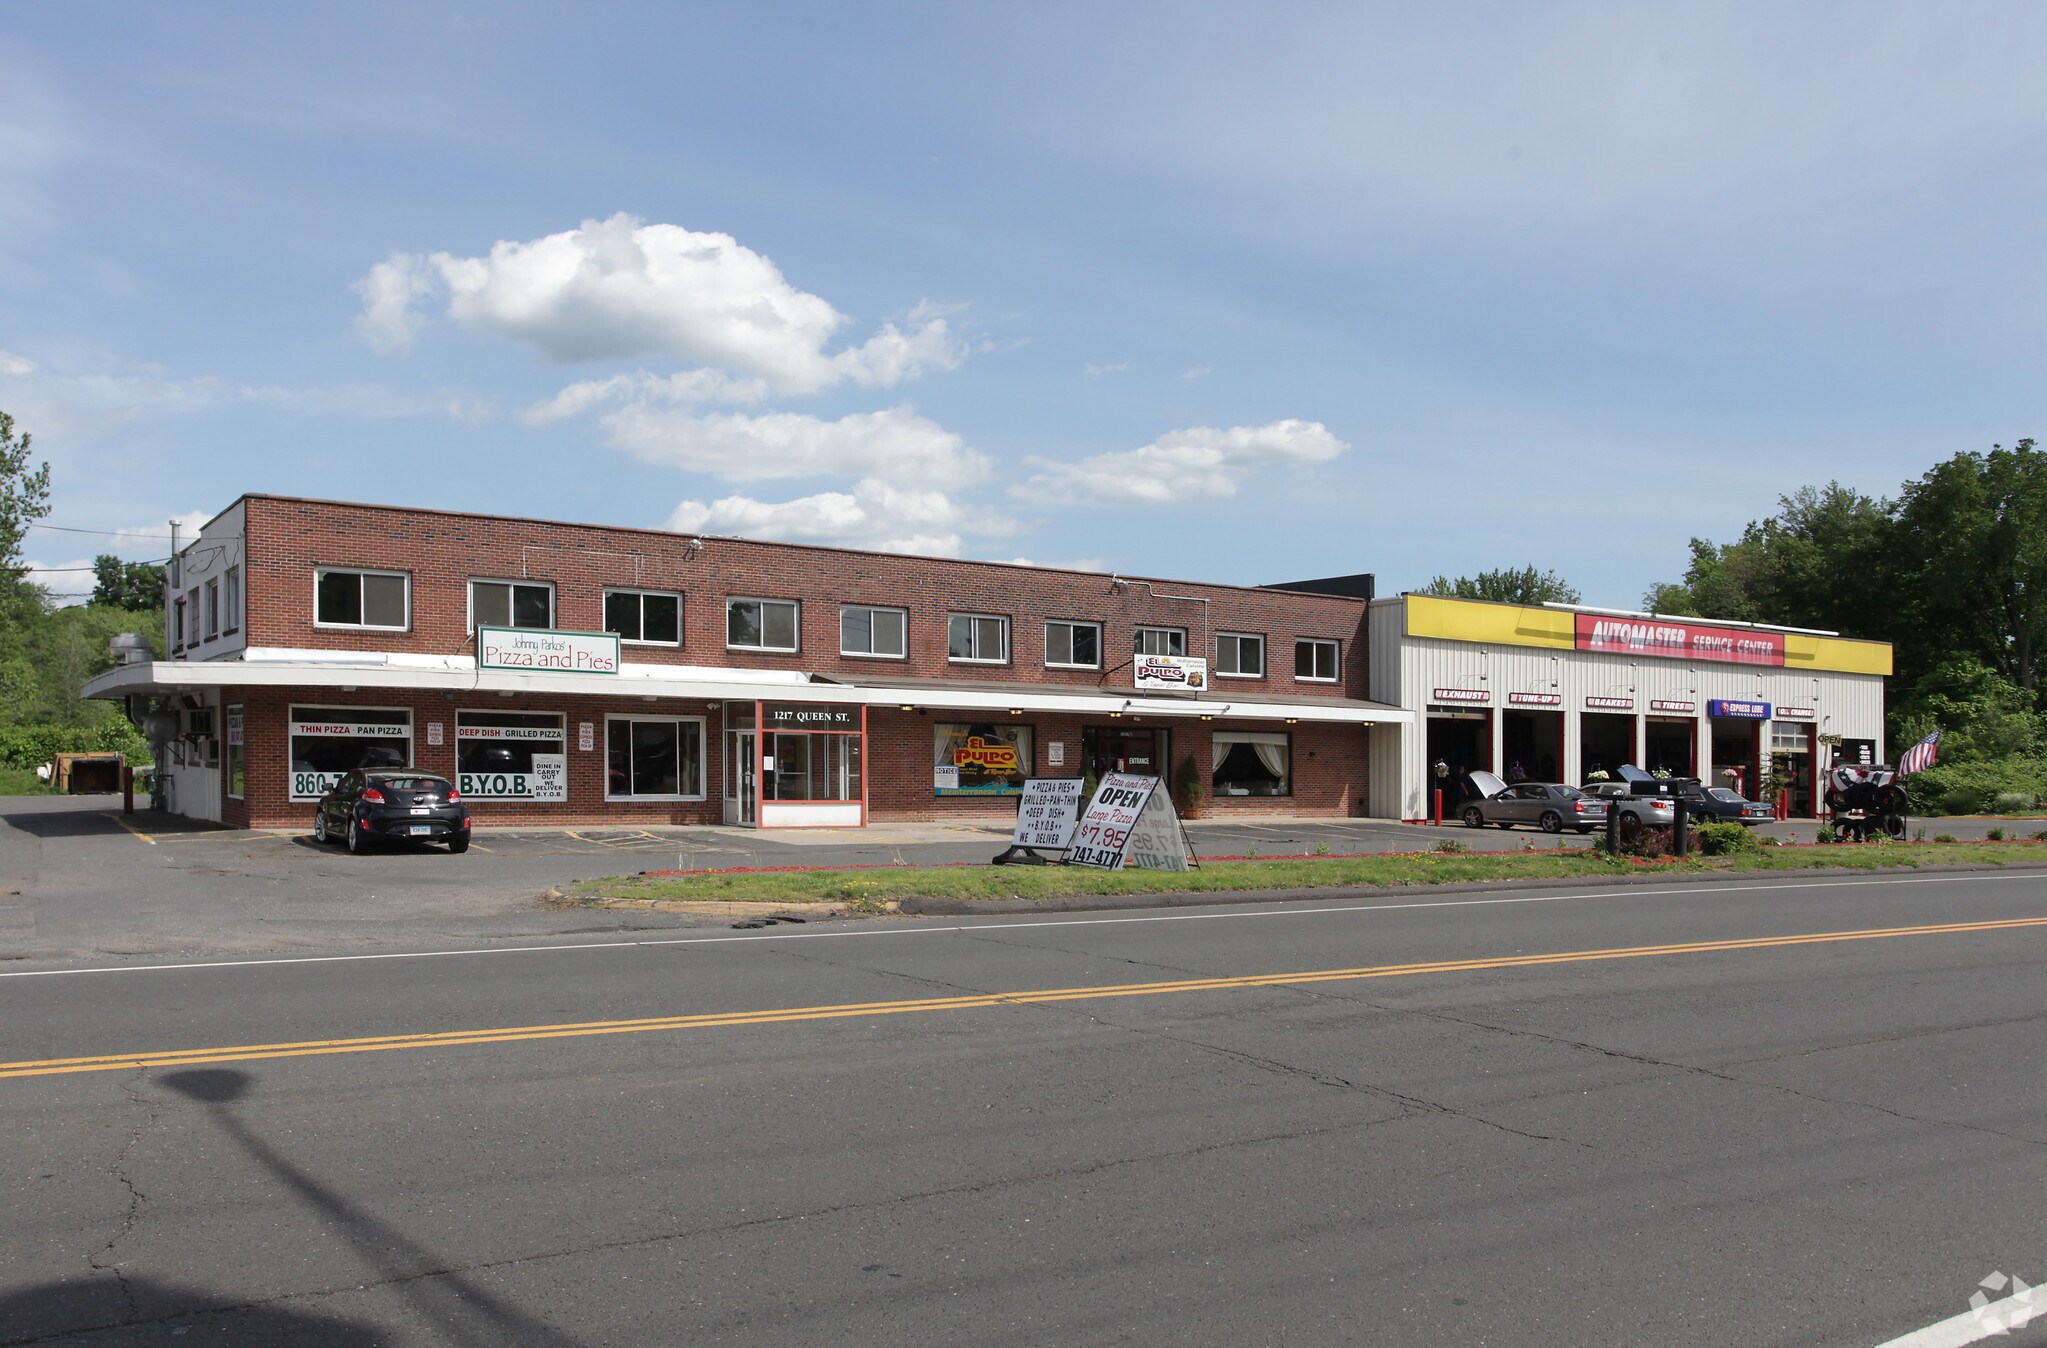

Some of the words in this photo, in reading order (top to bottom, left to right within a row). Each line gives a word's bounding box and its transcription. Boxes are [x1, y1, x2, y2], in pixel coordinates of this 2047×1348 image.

[512, 634, 538, 655] Johnny
[1590, 620, 1686, 649] AUTOMASTER
[1692, 635, 1733, 653] SERVICE
[1738, 639, 1774, 656] CENTER
[485, 646, 532, 666] Pizza
[538, 645, 572, 668] and
[577, 651, 613, 670] Pies
[1138, 666, 1183, 679] PULPO
[1442, 691, 1484, 700] EXHAUST
[1518, 694, 1552, 702] TUNE-UP
[1594, 698, 1626, 706] BRAKES
[1730, 704, 1750, 712] EXPRESS
[1752, 705, 1764, 714] LUBE
[774, 712, 793, 720] 1217
[796, 712, 832, 722] QUEEN
[836, 713, 850, 722] ST.
[1818, 735, 1840, 744] OPEN
[955, 749, 1014, 764] PULPO
[460, 775, 531, 794] B.Y.O.B.
[1058, 783, 1071, 792] PIES
[1105, 774, 1123, 786] Pizza
[1125, 778, 1141, 788] and
[1139, 778, 1154, 790] Pies
[1098, 788, 1144, 808] OPEN
[1029, 808, 1044, 817] DEEP
[1048, 808, 1062, 818] DISH
[1086, 806, 1108, 825] Large
[1110, 808, 1132, 824] Pizza
[1020, 833, 1028, 842] WE
[1036, 833, 1059, 844] DELIVER
[1081, 824, 1126, 848] $7.95
